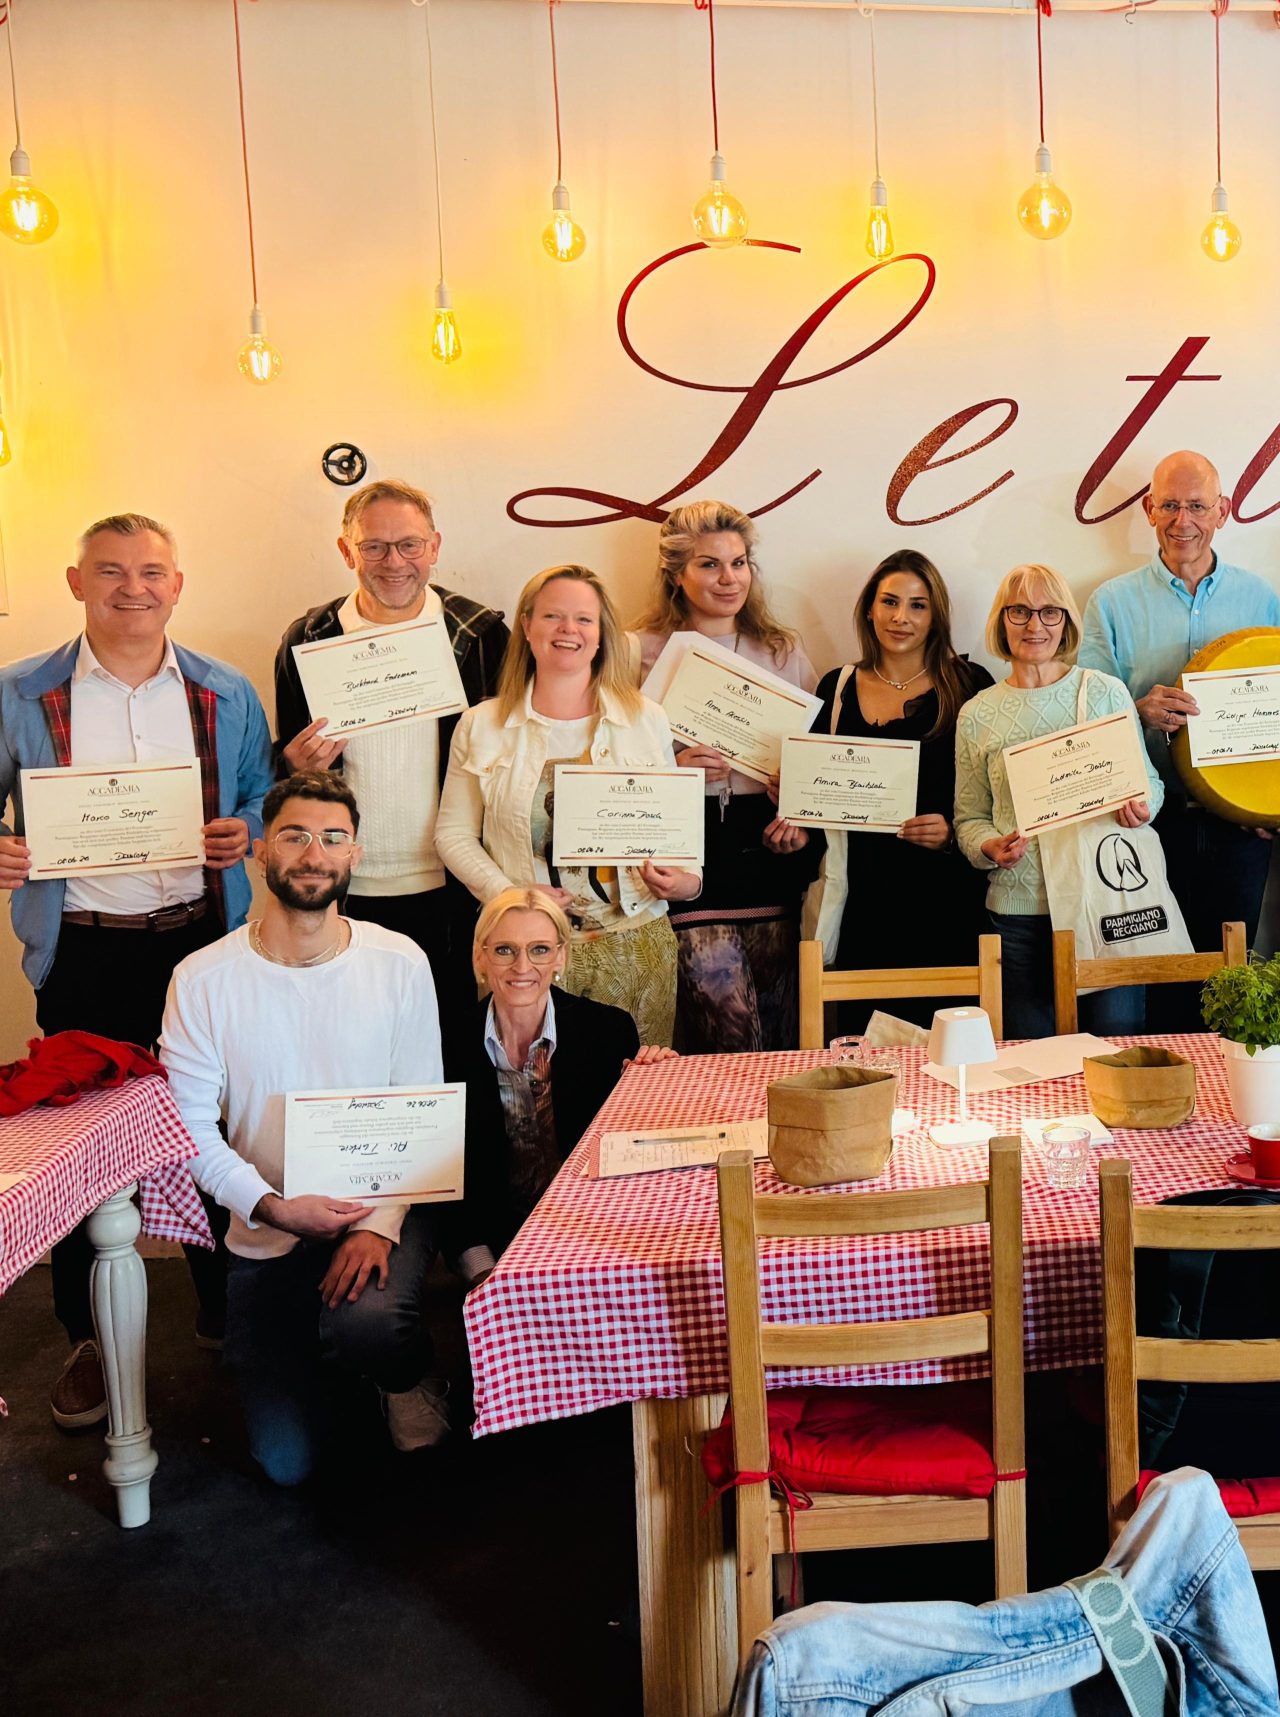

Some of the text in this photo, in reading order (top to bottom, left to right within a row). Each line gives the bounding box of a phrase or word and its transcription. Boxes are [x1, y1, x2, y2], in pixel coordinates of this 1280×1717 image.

[88, 785, 140, 796] ACCADEMIA
[1105, 909, 1160, 929] PARMIGIANO
[1113, 920, 1158, 938] REGGIANO
[349, 1172, 403, 1184] ACCADEMIA
